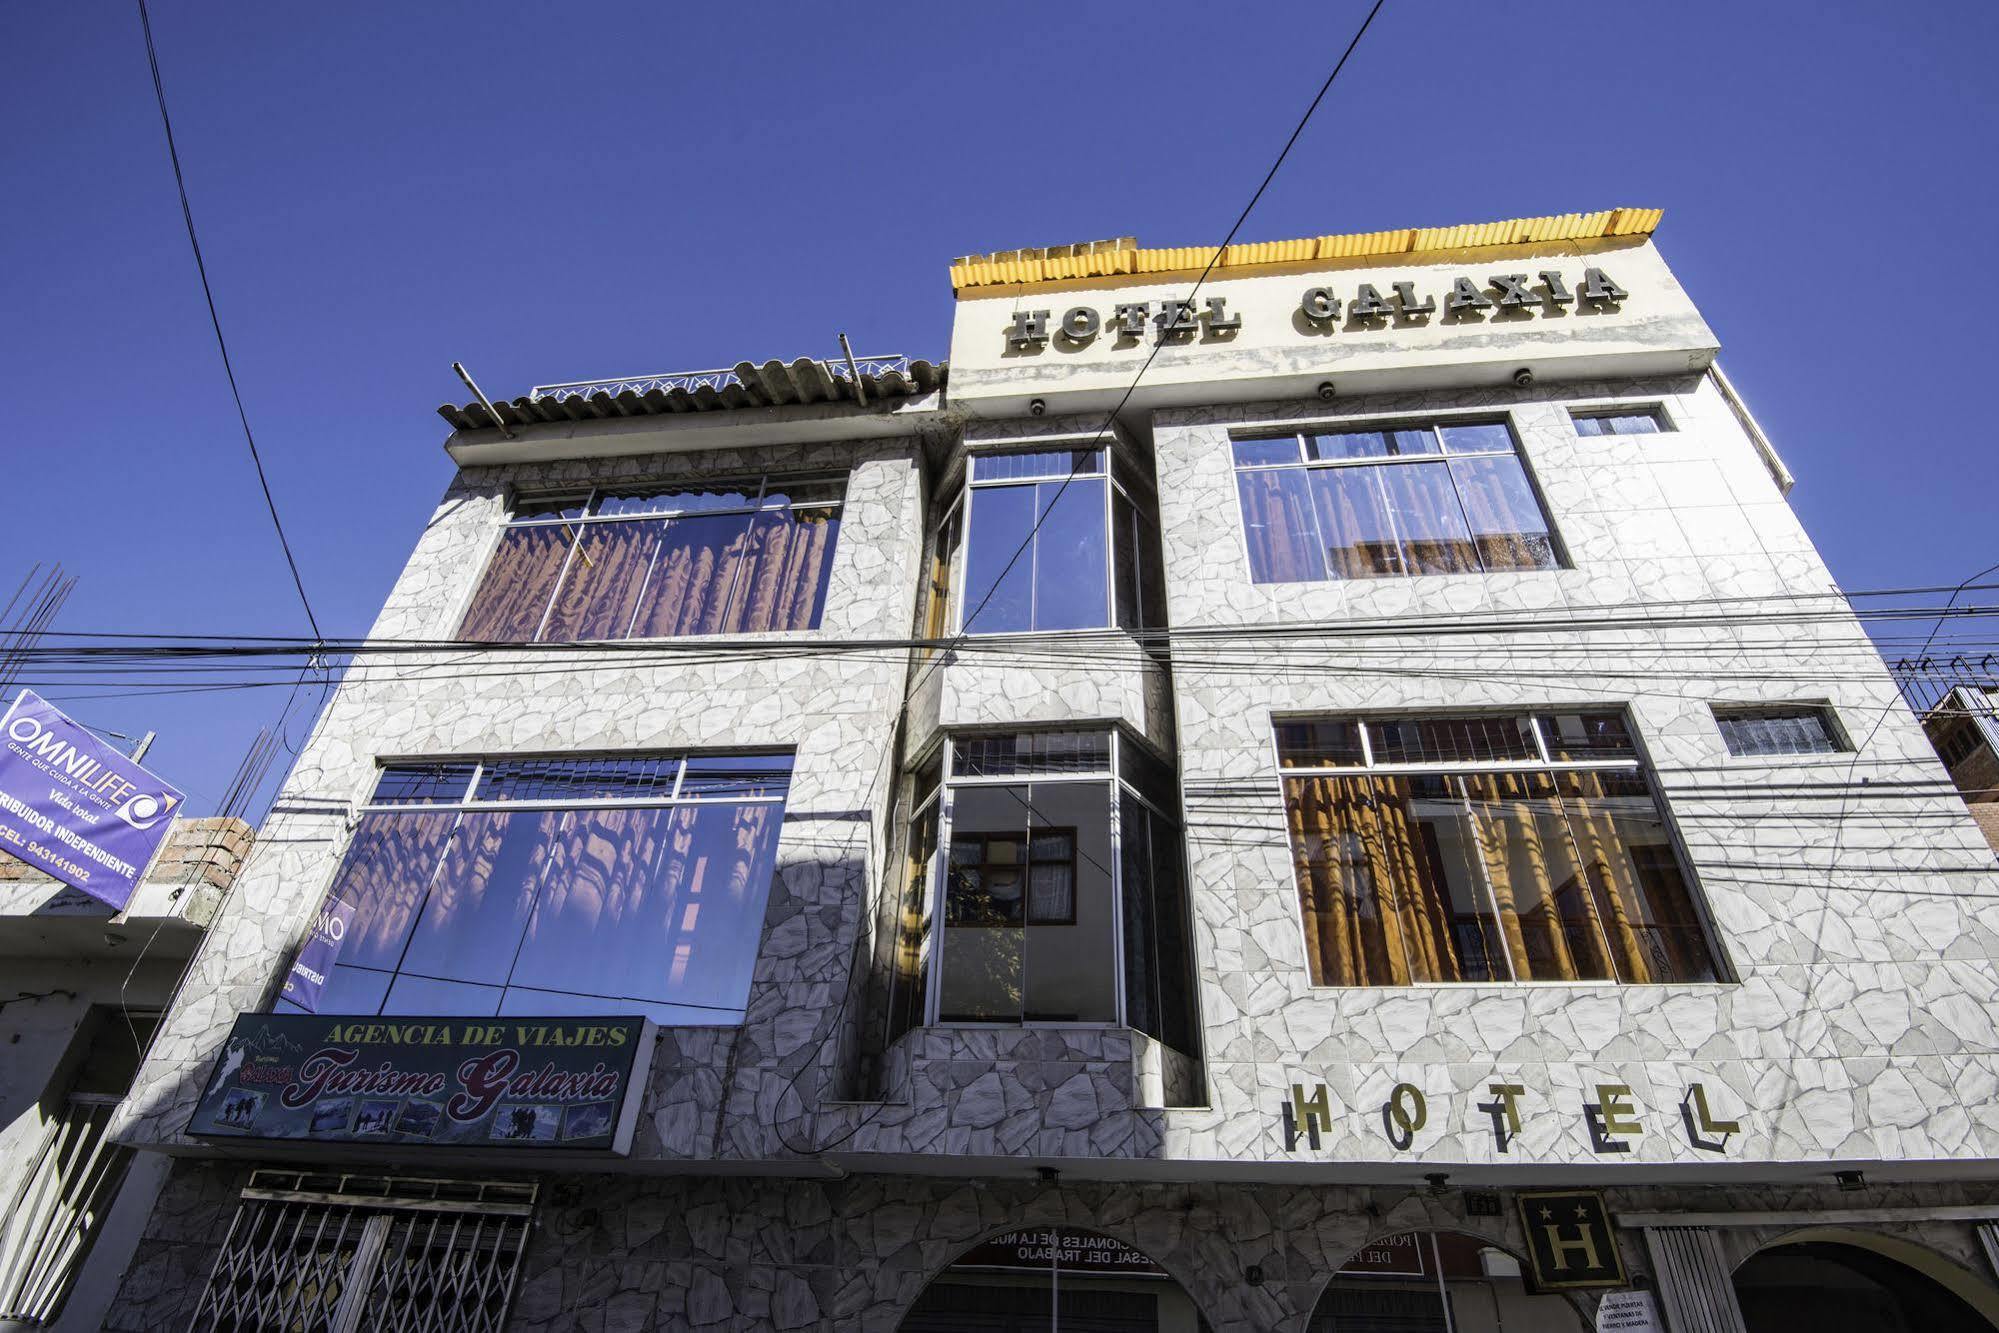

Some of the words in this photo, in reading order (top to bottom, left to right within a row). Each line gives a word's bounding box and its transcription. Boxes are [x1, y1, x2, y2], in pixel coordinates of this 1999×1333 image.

[1010, 297, 1242, 345] HOTEL
[1301, 267, 1630, 322] GALAXIA
[7, 741, 32, 762] GENTE
[32, 757, 50, 772] QUE
[49, 768, 72, 787] CUIDA
[79, 787, 90, 798] LA
[89, 794, 113, 811] GENTE
[8, 717, 137, 806] OMNILIFE
[27, 840, 91, 883] 943141902
[55, 824, 137, 879] INDEPENDIENTE
[324, 1024, 451, 1045] AGENCIA
[458, 1025, 504, 1046] DE
[516, 1026, 629, 1047] VIAJES
[281, 1047, 446, 1110] Turismo
[447, 1048, 619, 1123] Galaxia
[1291, 1083, 1740, 1134] HOTEL
[1545, 1223, 1603, 1270] H
